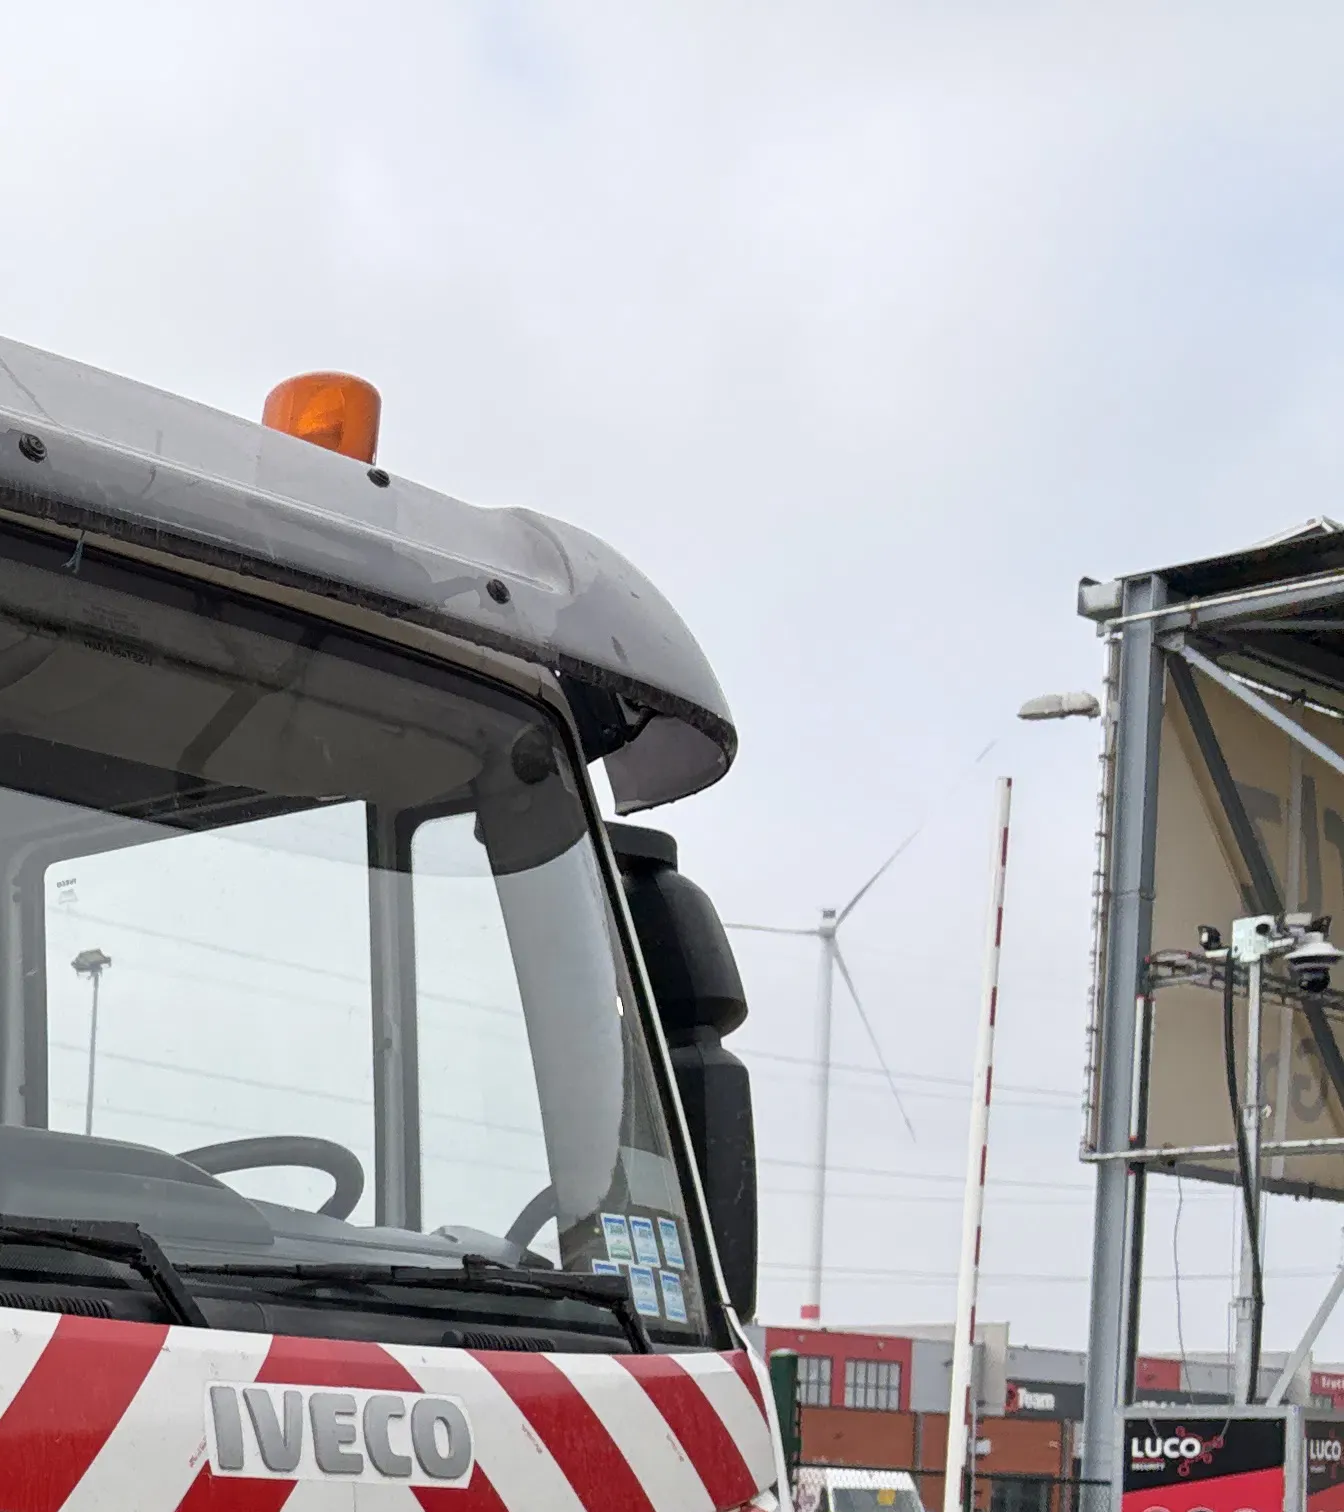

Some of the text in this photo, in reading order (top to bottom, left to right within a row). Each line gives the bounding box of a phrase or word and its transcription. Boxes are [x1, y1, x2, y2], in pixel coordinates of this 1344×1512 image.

[209, 1385, 472, 1480] IVECO
[1131, 1437, 1202, 1459] LUCO
[1310, 1439, 1341, 1460] LUCO
